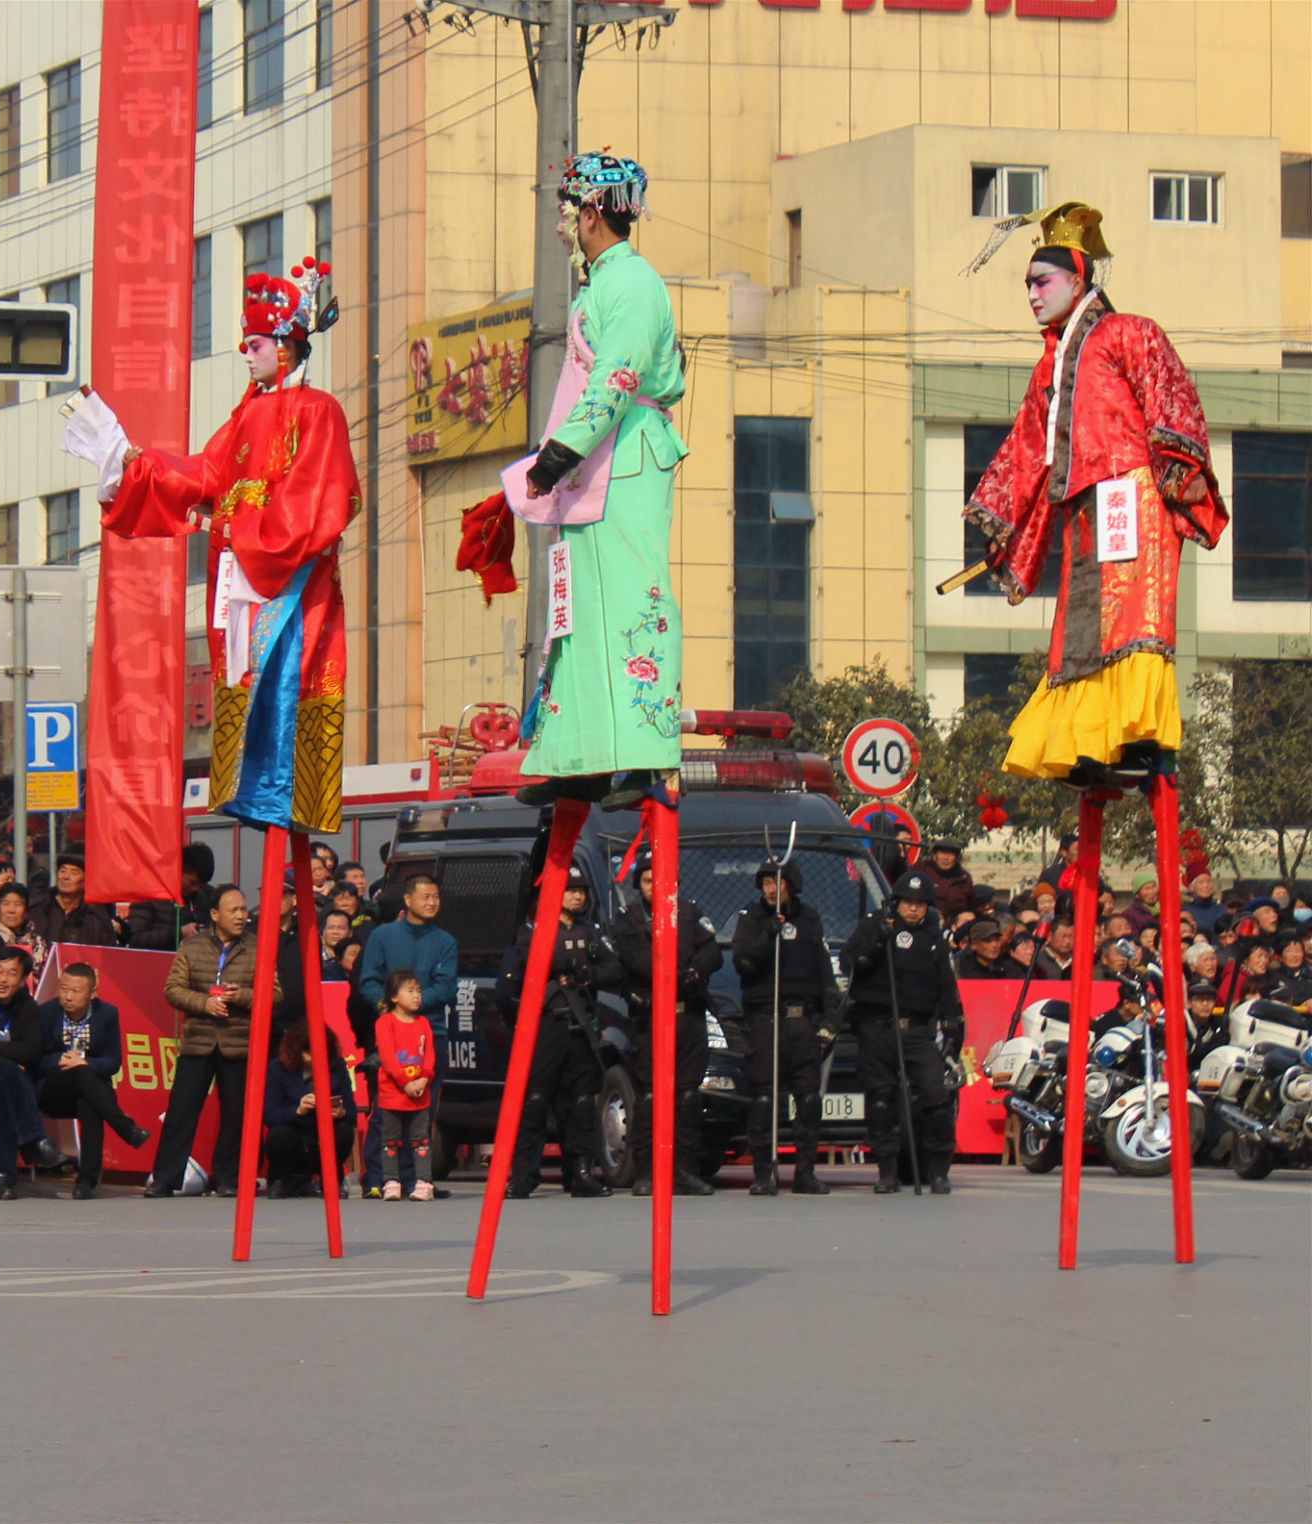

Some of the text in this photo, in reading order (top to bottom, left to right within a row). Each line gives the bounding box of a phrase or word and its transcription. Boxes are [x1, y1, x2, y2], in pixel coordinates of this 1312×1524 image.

[1106, 491, 1128, 552] 秦始皇
[28, 711, 71, 767] P
[858, 740, 904, 775] 40
[445, 980, 477, 1031] 警
[111, 1033, 180, 1090] 邑区
[449, 1041, 476, 1068] LICE
